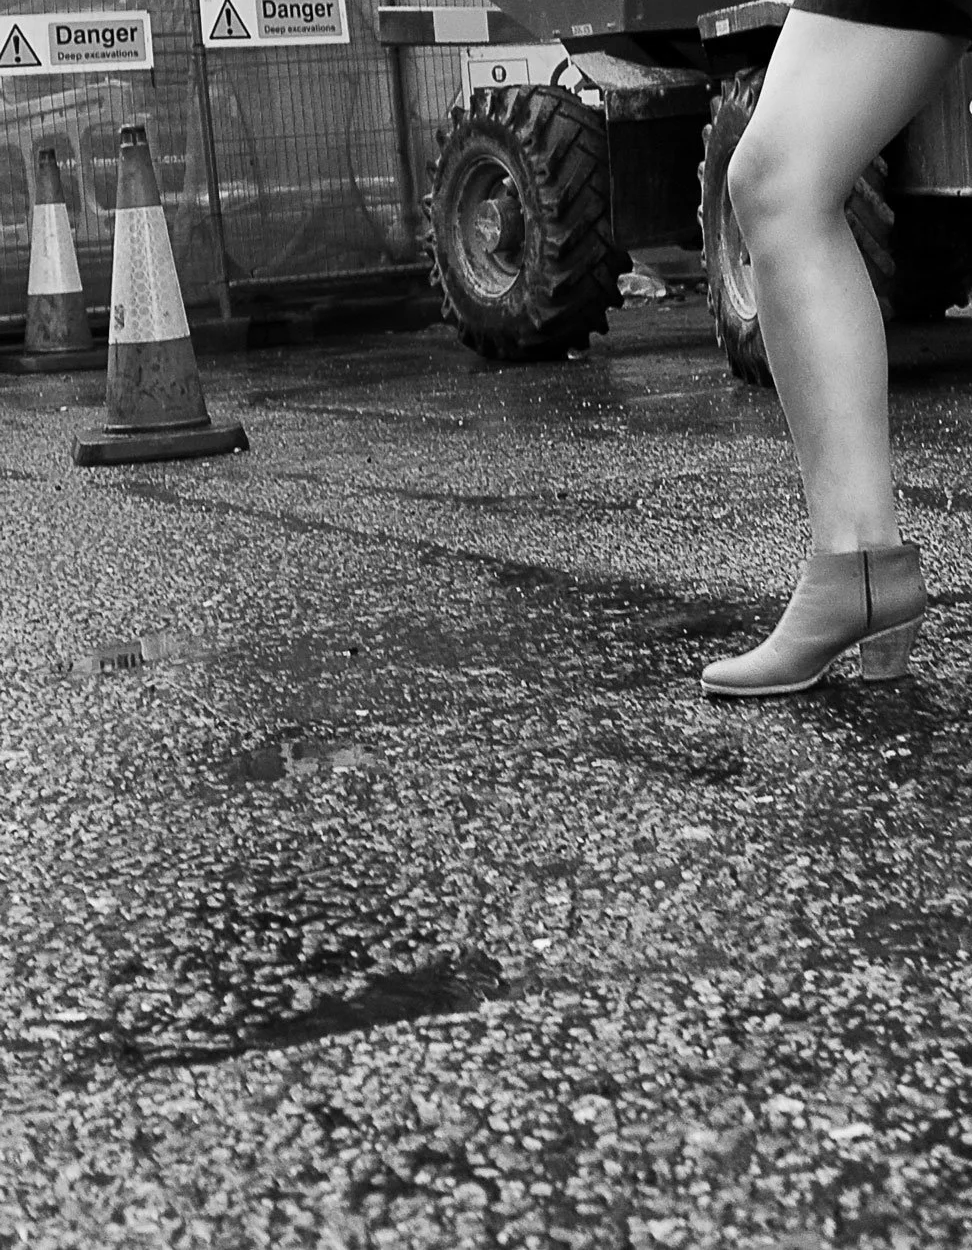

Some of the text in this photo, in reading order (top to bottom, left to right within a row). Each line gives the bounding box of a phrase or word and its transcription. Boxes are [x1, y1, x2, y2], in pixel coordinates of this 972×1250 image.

[261, 0, 334, 23] Danger
[56, 25, 138, 48] Danger
[264, 23, 336, 35] Deep excavations
[57, 50, 139, 62] Deep excavations
